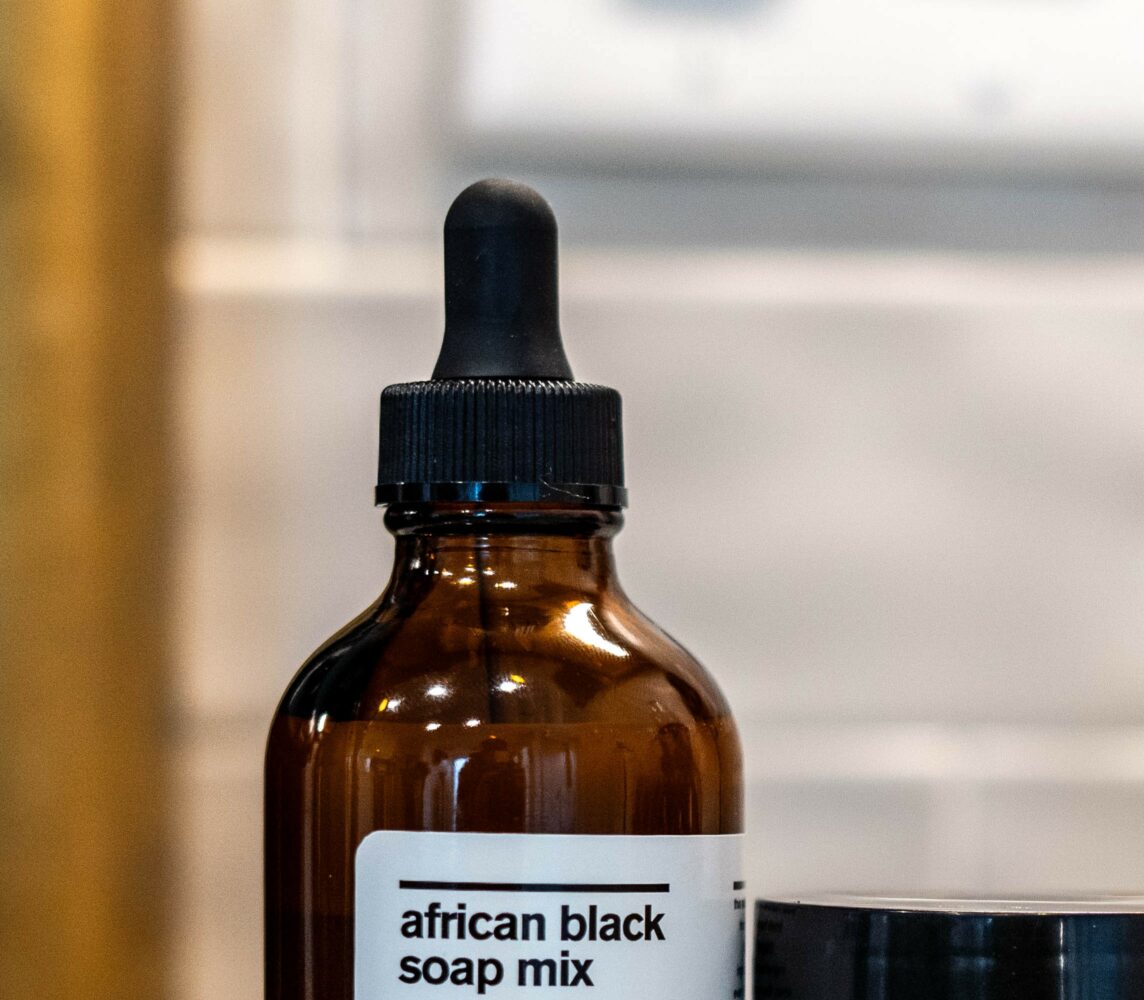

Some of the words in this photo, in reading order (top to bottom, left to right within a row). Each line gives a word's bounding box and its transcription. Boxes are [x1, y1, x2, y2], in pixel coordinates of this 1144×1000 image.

[400, 902, 546, 941] african
[560, 905, 665, 941] black
[399, 954, 504, 994] soap
[517, 950, 594, 987] mix
